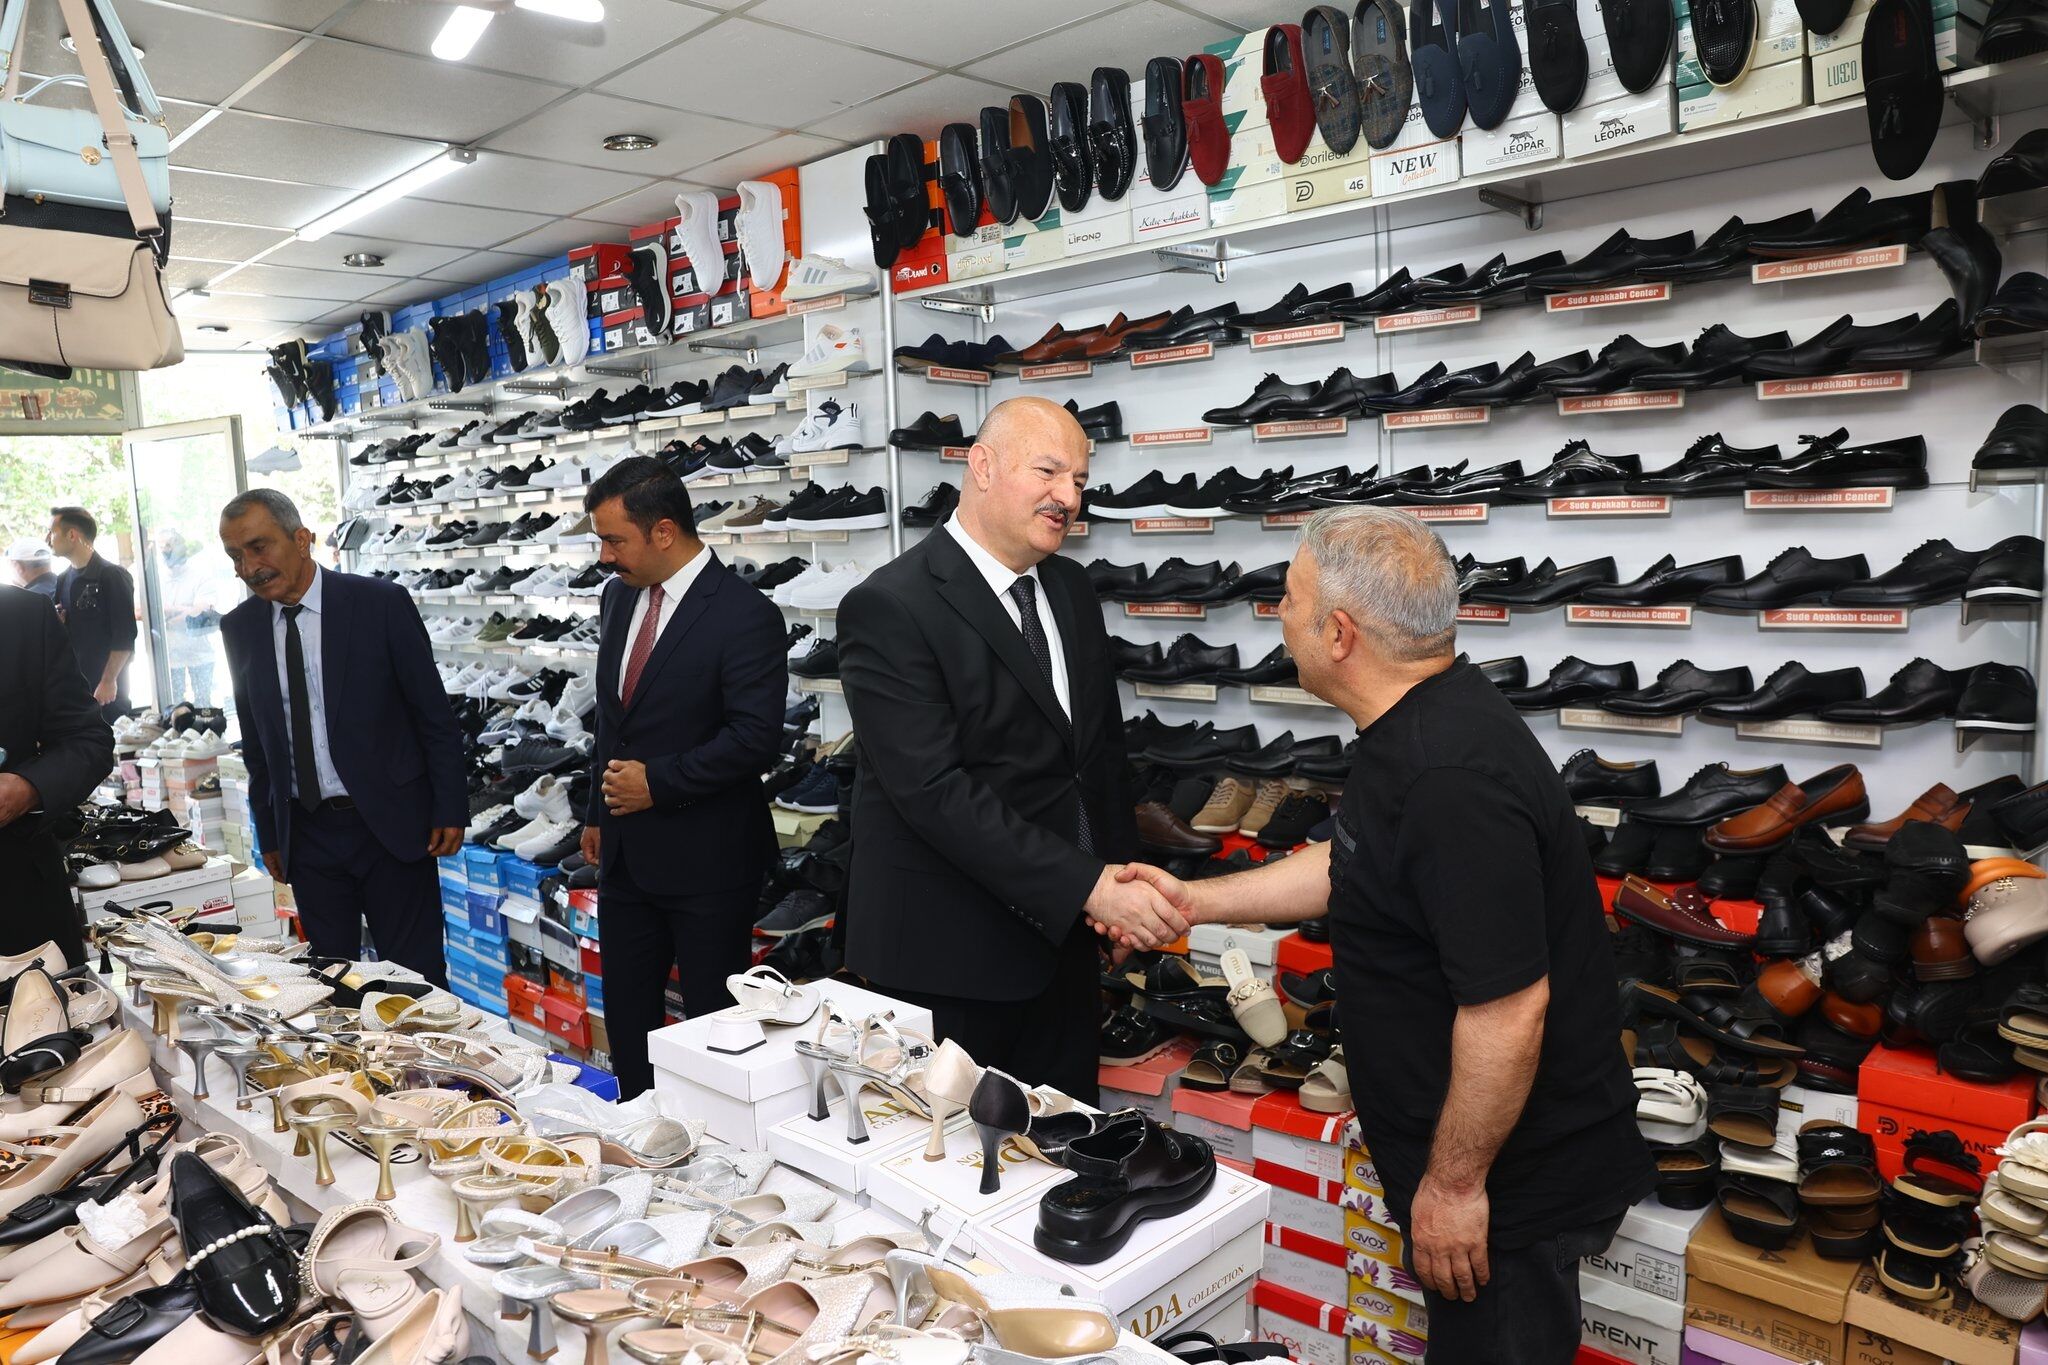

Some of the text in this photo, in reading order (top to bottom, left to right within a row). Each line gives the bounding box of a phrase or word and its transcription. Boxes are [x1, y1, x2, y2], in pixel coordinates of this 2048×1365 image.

[1594, 124, 1635, 143] LEOPAR
[1503, 139, 1545, 156] LEOPAR
[1389, 152, 1438, 177] NEW
[1402, 167, 1437, 186] Collection
[1349, 181, 1364, 191] 46
[1779, 264, 1804, 274] Sude
[1855, 253, 1892, 265] Center
[1567, 297, 1588, 305] Sude
[1629, 288, 1659, 298] Center
[1446, 309, 1471, 320] Center
[1313, 326, 1336, 337] Center
[1185, 346, 1205, 356] Center
[1784, 383, 1809, 392] Sude
[1860, 376, 1896, 386] Center
[1581, 399, 1602, 408] Sude
[1643, 394, 1673, 404] Center
[1401, 415, 1420, 423] Sude
[1454, 410, 1480, 420] Center
[1845, 492, 1880, 501] Center
[1569, 500, 1590, 510] Sude
[1631, 499, 1660, 509] Center
[1475, 608, 1500, 617] Center
[1589, 609, 1610, 618] Sude
[1651, 610, 1681, 620] Center
[1785, 612, 1896, 623] Sude Ayakkabı Center
[1195, 964, 1225, 976] KARDE
[1355, 1166, 1381, 1183] avo
[1187, 1264, 1245, 1309] COLLECTION
[1262, 1327, 1303, 1354] VOGA
[1581, 1317, 1658, 1355] ARENT
